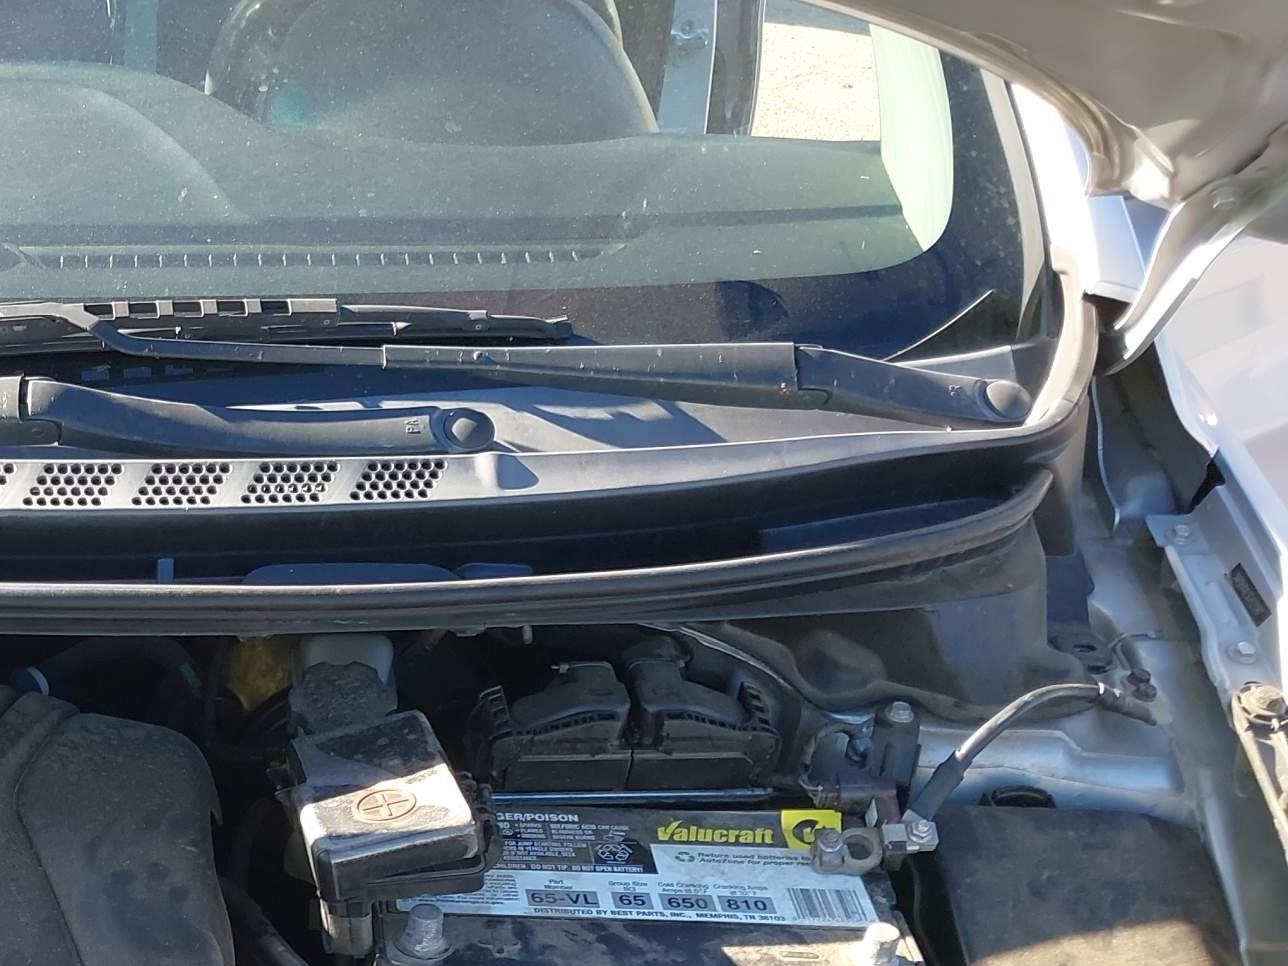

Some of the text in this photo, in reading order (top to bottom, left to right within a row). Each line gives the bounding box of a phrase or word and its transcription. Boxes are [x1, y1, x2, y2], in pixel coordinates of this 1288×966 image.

[657, 820, 774, 844] Valucraft
[530, 892, 599, 905] 65-VL
[619, 894, 646, 906] 65
[667, 897, 709, 909] 650
[727, 899, 768, 912] 810
[534, 908, 594, 916] DISTRIBUTED
[610, 909, 633, 917] BEST
[634, 910, 669, 918] PARTS,
[696, 912, 743, 920] MEMPHIS,
